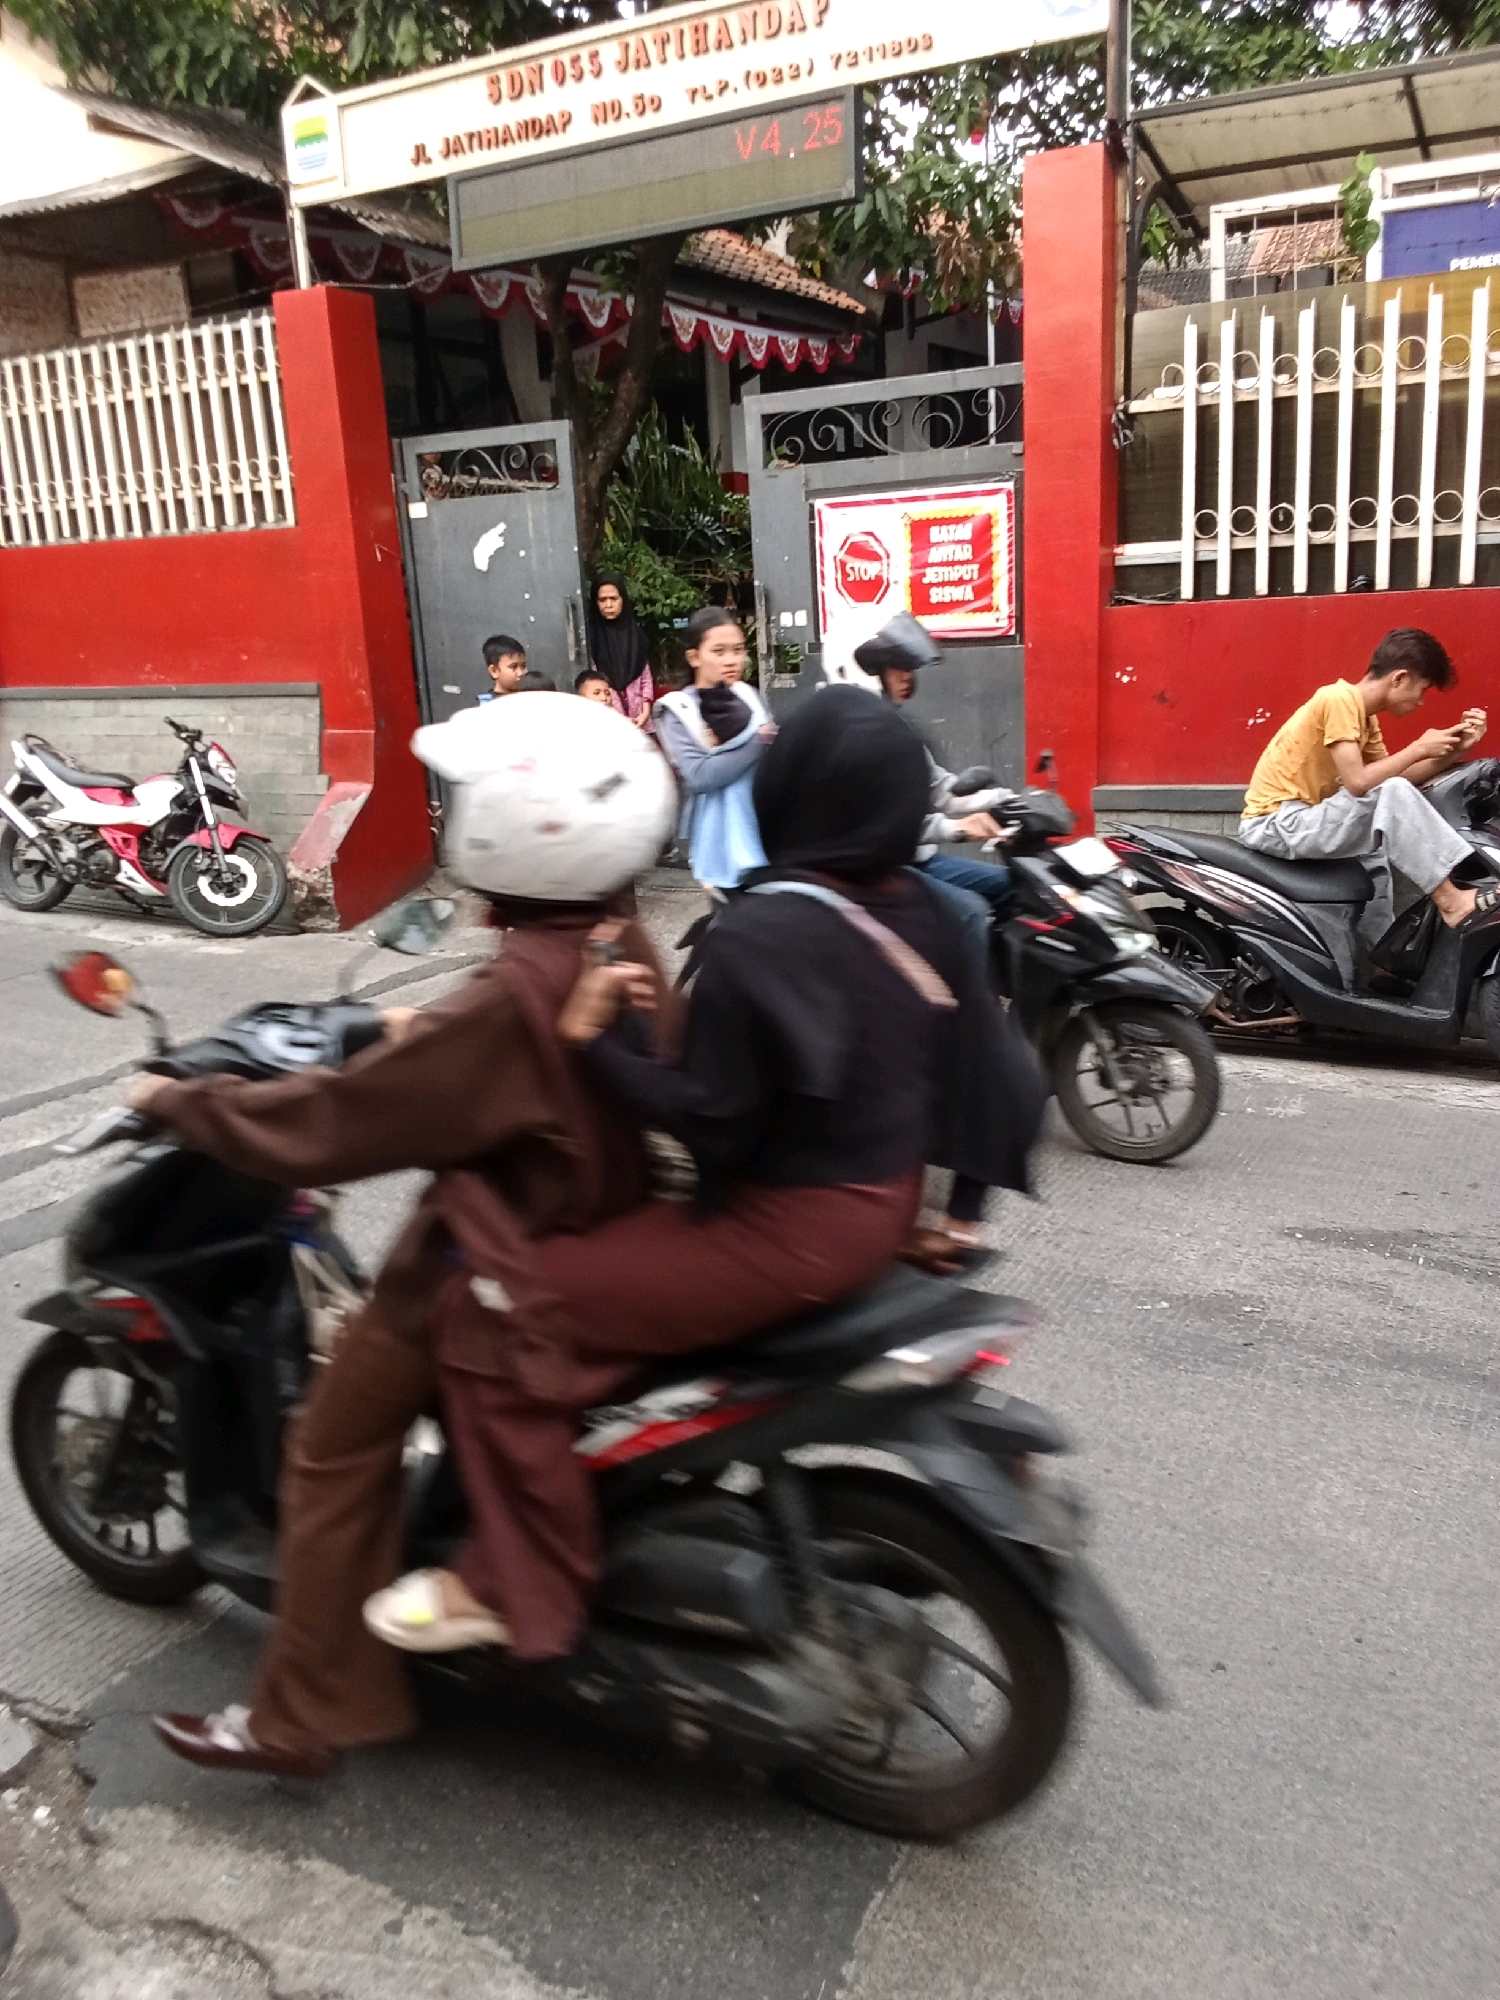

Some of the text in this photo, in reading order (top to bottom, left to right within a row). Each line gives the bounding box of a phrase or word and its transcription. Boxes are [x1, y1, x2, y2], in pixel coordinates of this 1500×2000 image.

[486, 0, 829, 104] SDN 055 JATIHANDAP
[439, 109, 572, 158] JATIHANDAP
[929, 523, 972, 543] BATAS
[928, 544, 973, 563] ANTAR
[845, 561, 882, 582] STOP
[921, 564, 980, 584] JEMPUT
[929, 585, 974, 604] SISWA
